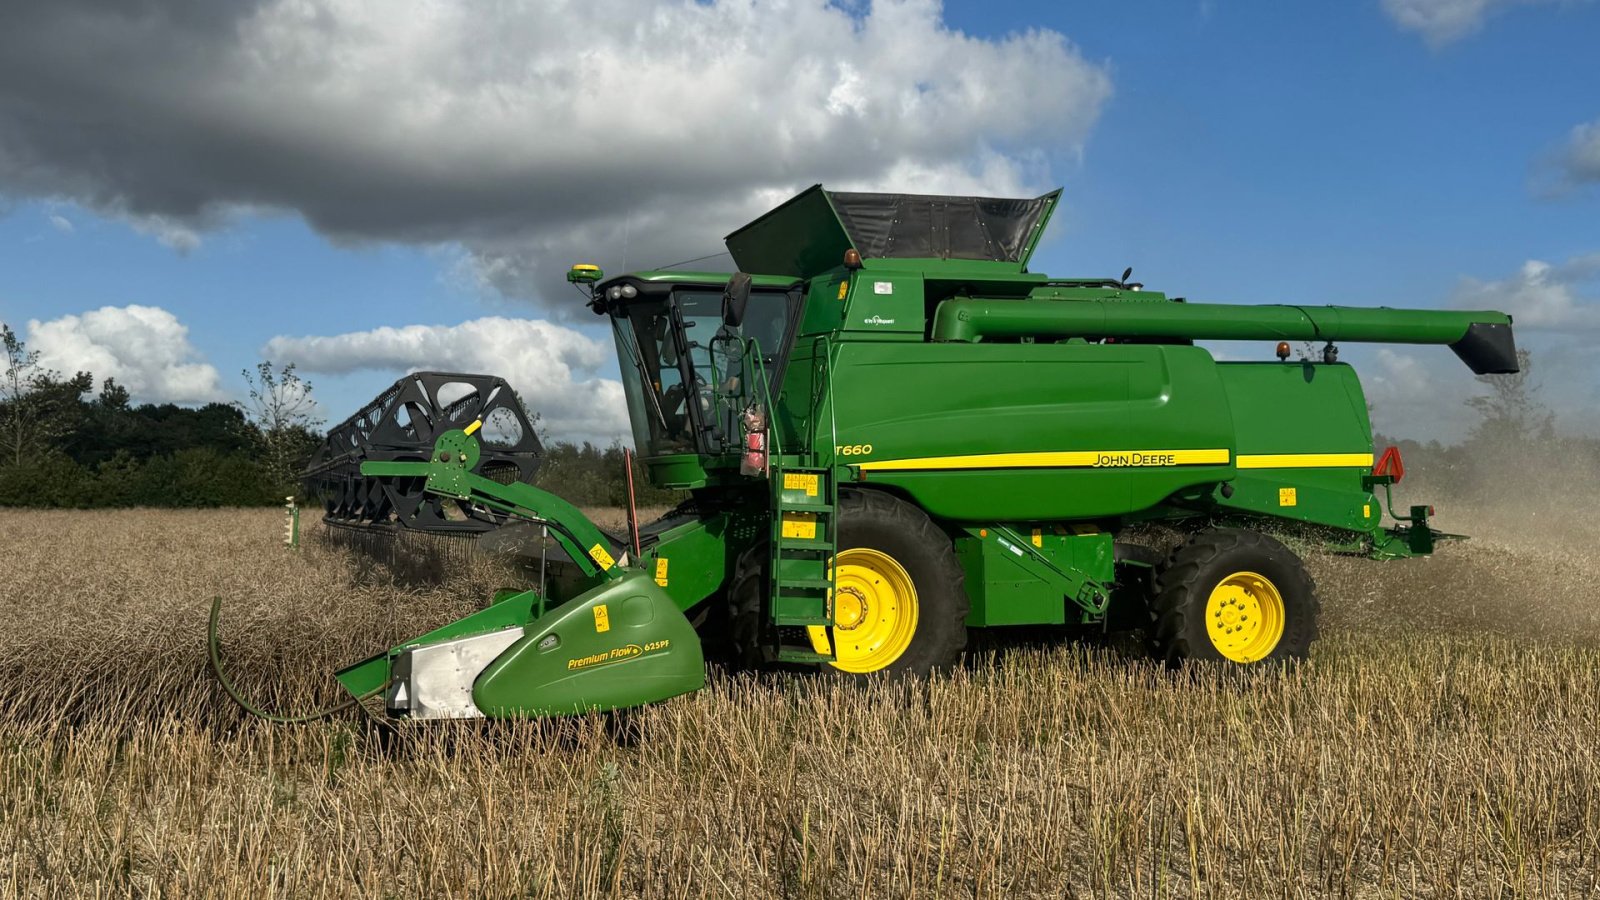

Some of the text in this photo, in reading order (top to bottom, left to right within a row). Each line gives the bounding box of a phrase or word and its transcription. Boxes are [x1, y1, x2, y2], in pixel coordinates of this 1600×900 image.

[836, 444, 873, 456] T660
[1093, 453, 1175, 466] JOHN DEERE
[568, 640, 669, 669] Premium Flow 625PF
